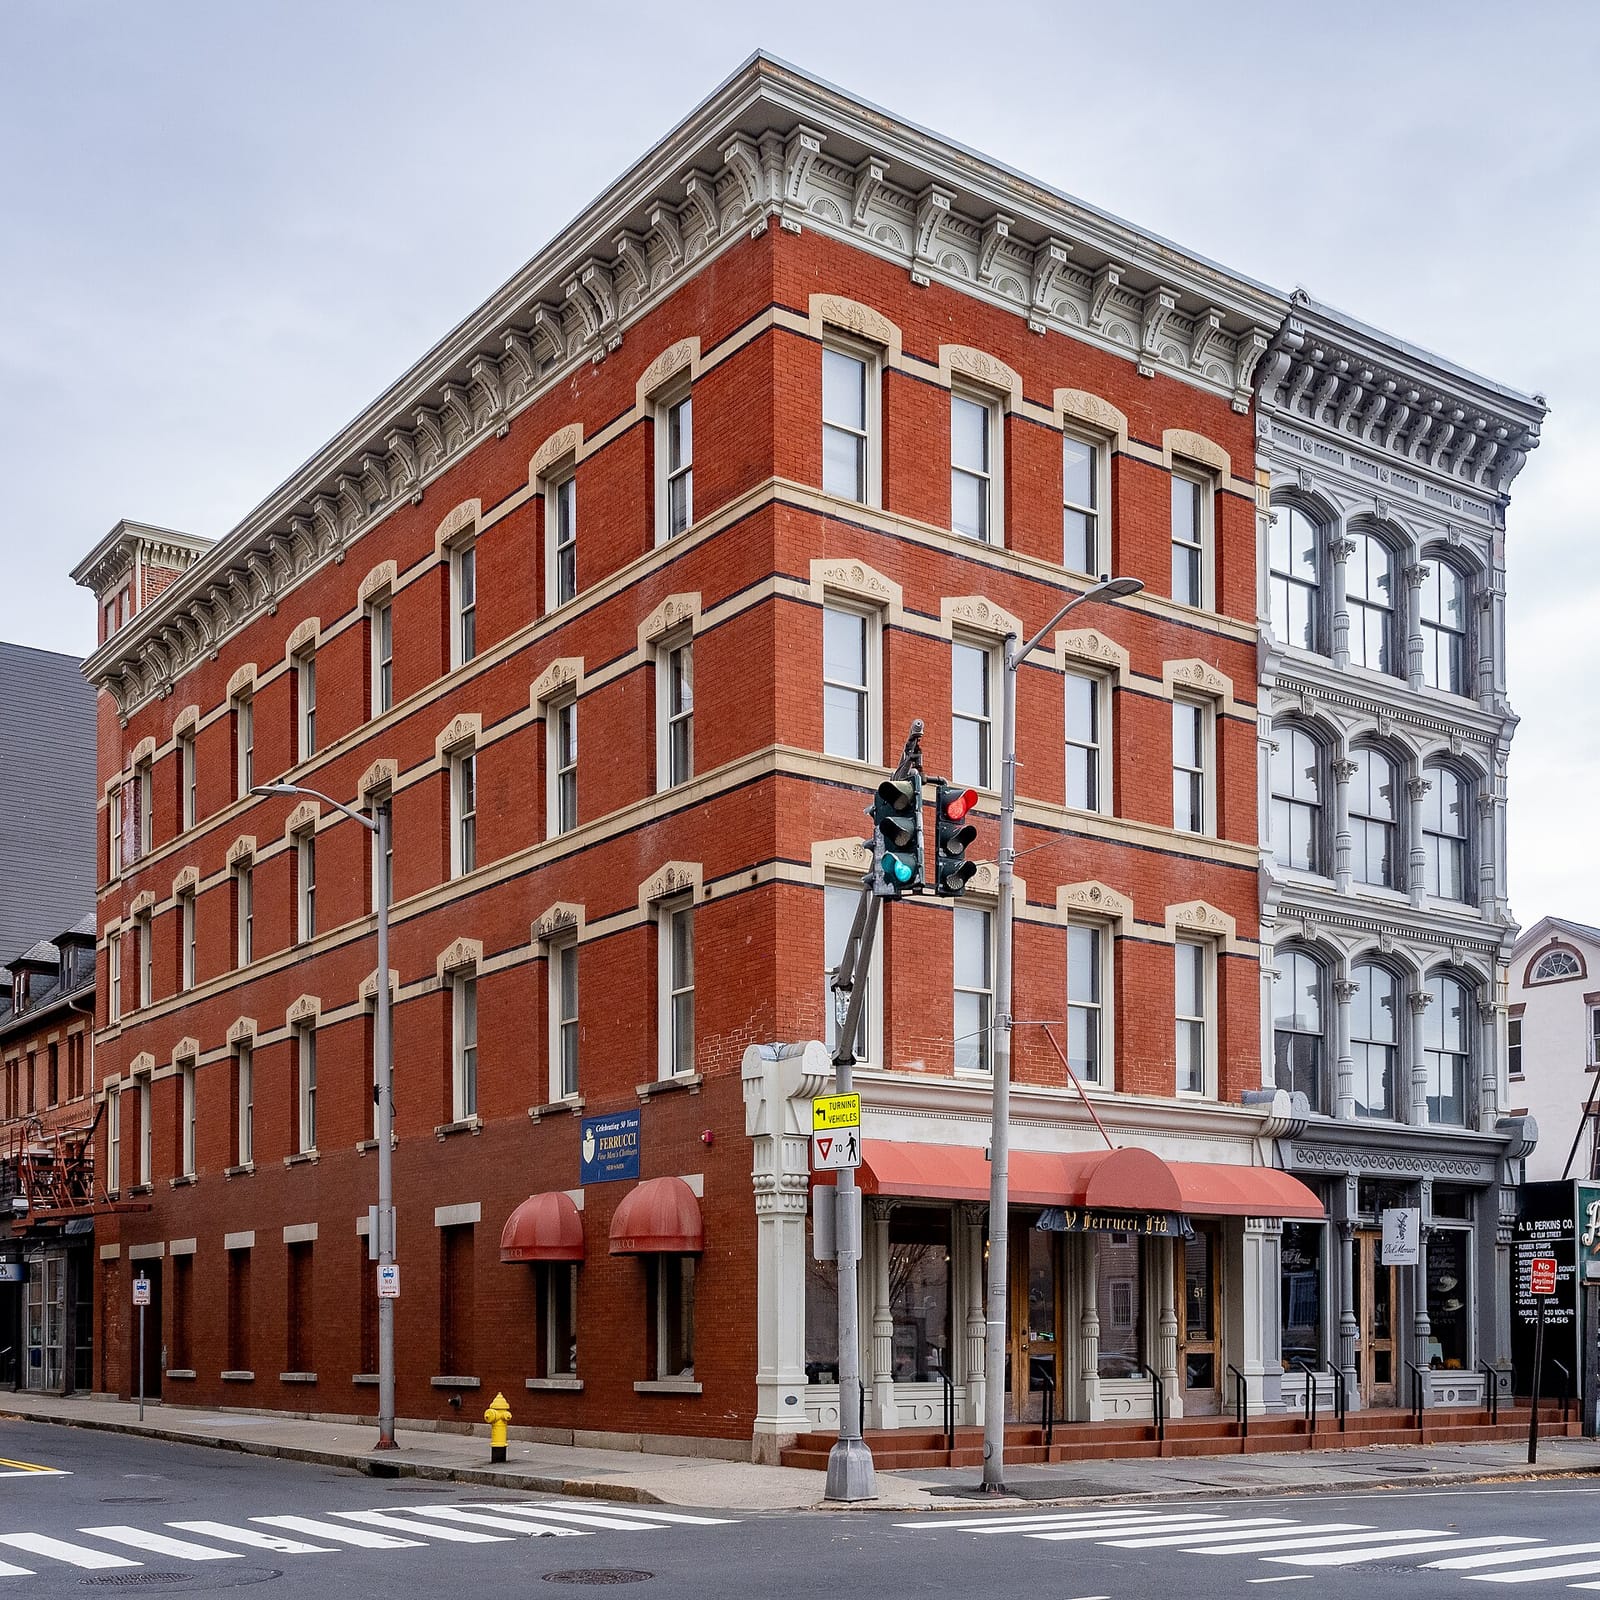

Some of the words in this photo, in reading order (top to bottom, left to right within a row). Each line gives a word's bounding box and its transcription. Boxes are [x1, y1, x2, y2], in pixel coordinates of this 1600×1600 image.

[829, 1100, 856, 1111] TURNING
[828, 1113, 857, 1123] VEHICLES
[600, 1133, 636, 1150] FERRUCCI
[1518, 1222, 1524, 1231] A.
[1526, 1221, 1533, 1231] D.
[1534, 1220, 1560, 1230] PERKINS
[1562, 1218, 1574, 1229] CO.
[1538, 1262, 1550, 1270] No
[1533, 1270, 1554, 1278] Standing
[1194, 1287, 1202, 1298] 51
